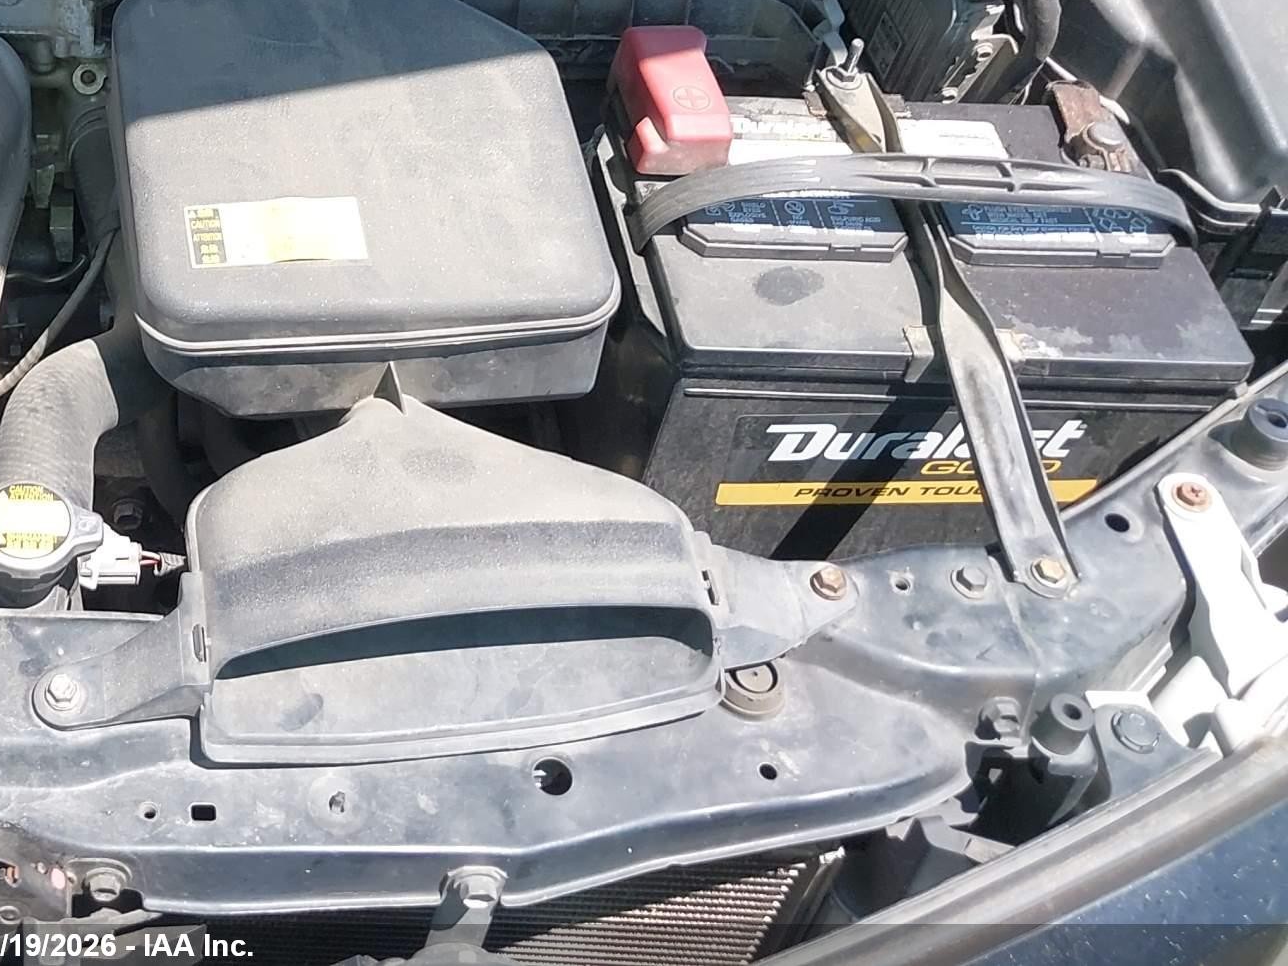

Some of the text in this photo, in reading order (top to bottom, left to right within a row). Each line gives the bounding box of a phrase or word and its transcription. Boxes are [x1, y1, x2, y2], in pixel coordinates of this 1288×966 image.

[191, 219, 221, 230] CAUTION
[766, 420, 1085, 461] Duralt
[9, 484, 43, 494] CAUTION
[794, 486, 983, 497] PROVEN TOU
